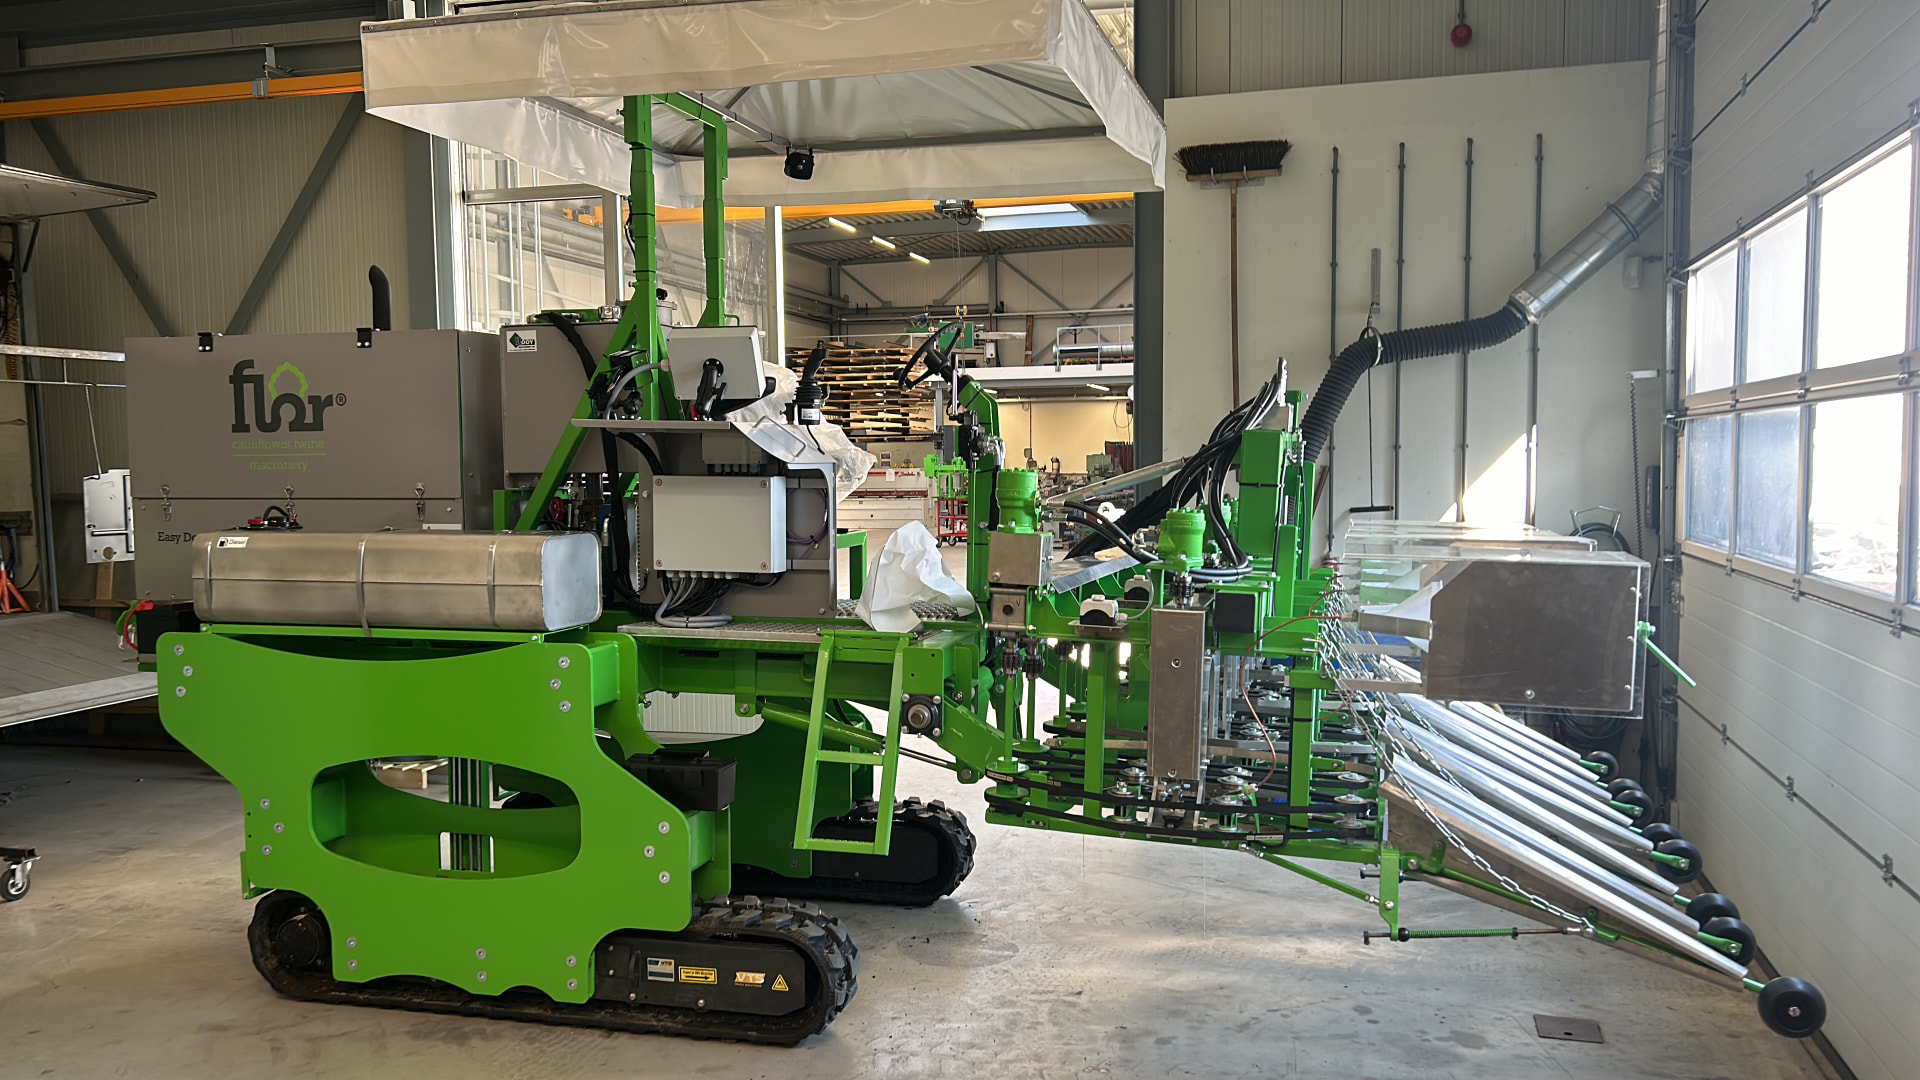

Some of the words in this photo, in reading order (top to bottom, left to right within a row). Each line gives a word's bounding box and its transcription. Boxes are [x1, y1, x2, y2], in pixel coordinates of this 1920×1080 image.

[231, 439, 290, 450] cauliflower
[294, 439, 325, 449] twine
[249, 461, 308, 472] machinery
[157, 531, 181, 545] Easy
[735, 971, 766, 984] VTS
